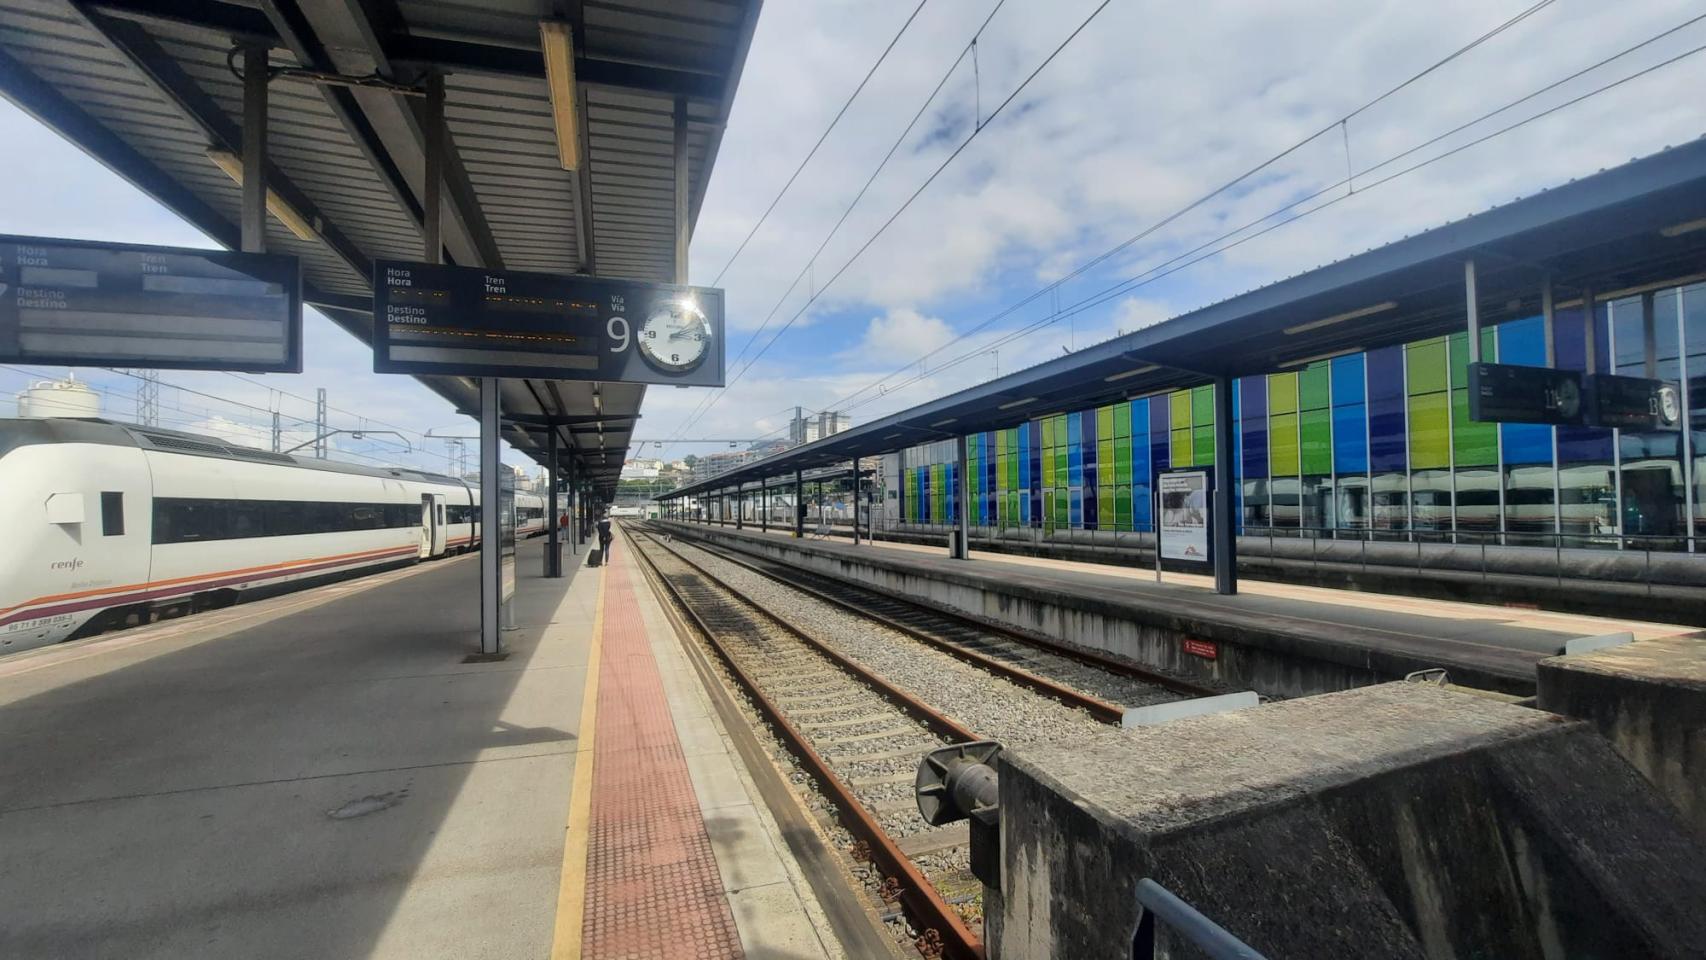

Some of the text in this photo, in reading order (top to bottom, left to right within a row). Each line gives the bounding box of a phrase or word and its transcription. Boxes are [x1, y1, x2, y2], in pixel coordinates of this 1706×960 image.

[17, 256, 48, 265] Hora
[141, 263, 168, 273] Tren
[387, 267, 410, 277] Hora
[387, 277, 412, 286] Hora
[484, 275, 505, 285] Tren
[17, 287, 65, 299] Destino
[484, 284, 506, 294] Tren
[17, 297, 67, 309] Destino
[387, 304, 425, 315] Destino
[387, 314, 427, 324] Destino
[607, 316, 630, 353] 9
[648, 331, 657, 339] 9
[671, 353, 679, 362] 6
[51, 556, 84, 571] renfe
